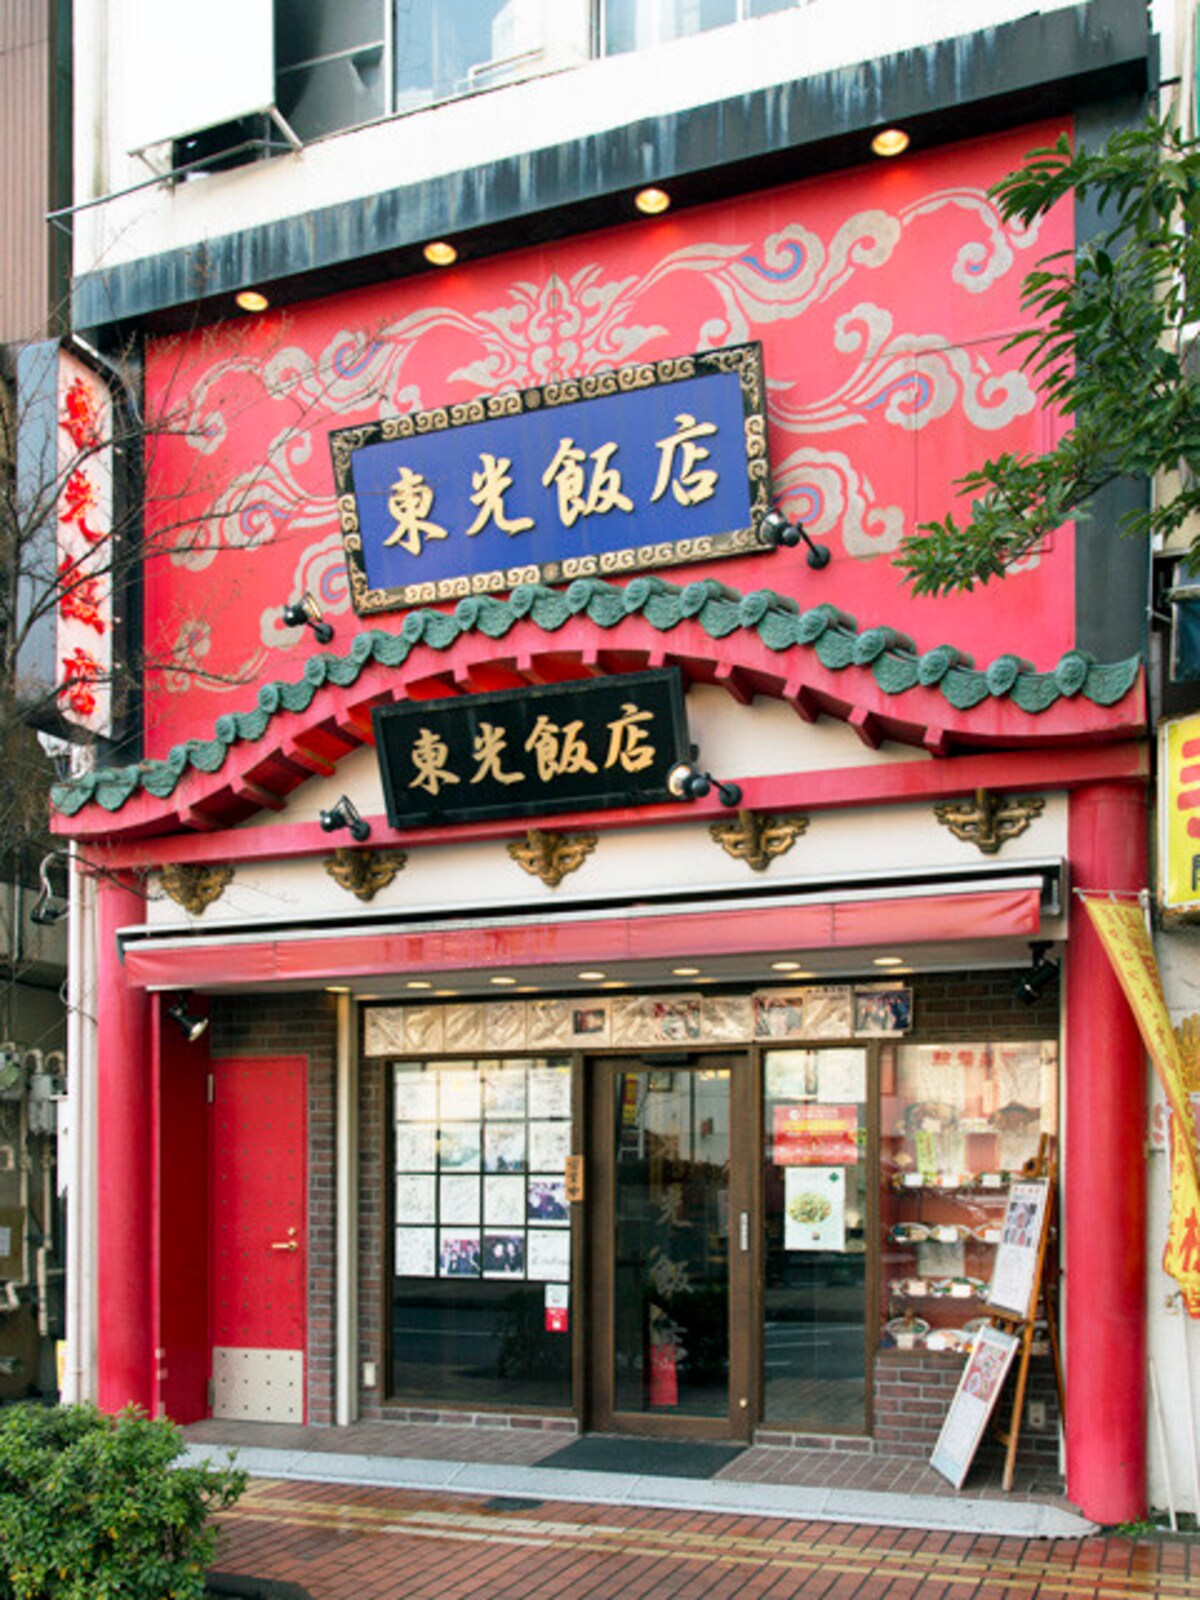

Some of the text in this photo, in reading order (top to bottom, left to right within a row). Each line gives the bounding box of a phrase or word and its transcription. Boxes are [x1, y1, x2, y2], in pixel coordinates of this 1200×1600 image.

[383, 413, 719, 556] 東光飯店
[408, 703, 657, 794] 東光飯店
